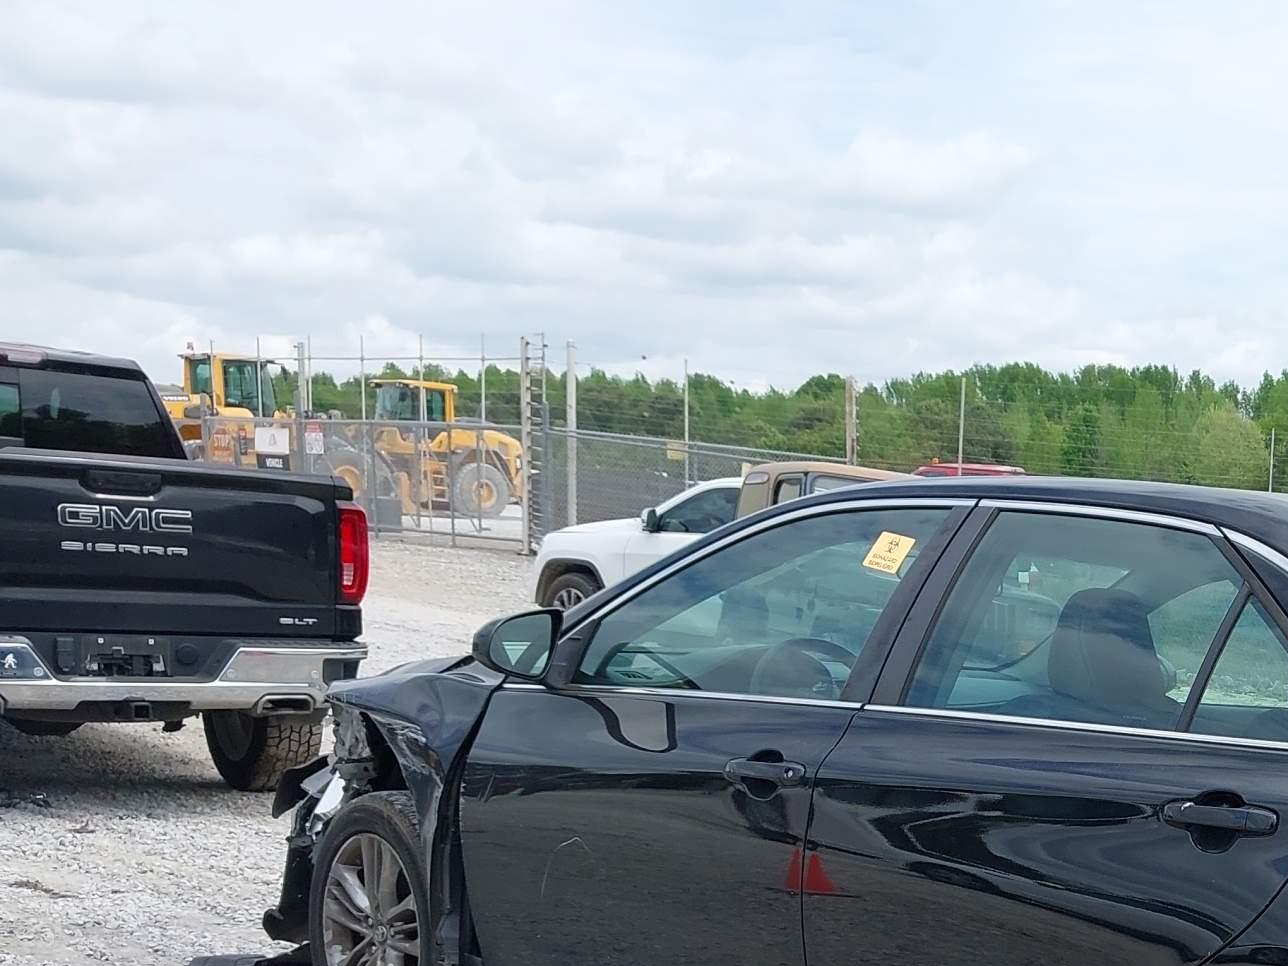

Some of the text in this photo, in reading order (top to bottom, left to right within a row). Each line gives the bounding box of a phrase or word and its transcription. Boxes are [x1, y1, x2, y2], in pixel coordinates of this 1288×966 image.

[57, 502, 193, 533] GMC
[60, 540, 189, 556] SIERRA
[279, 617, 319, 625] SLT
